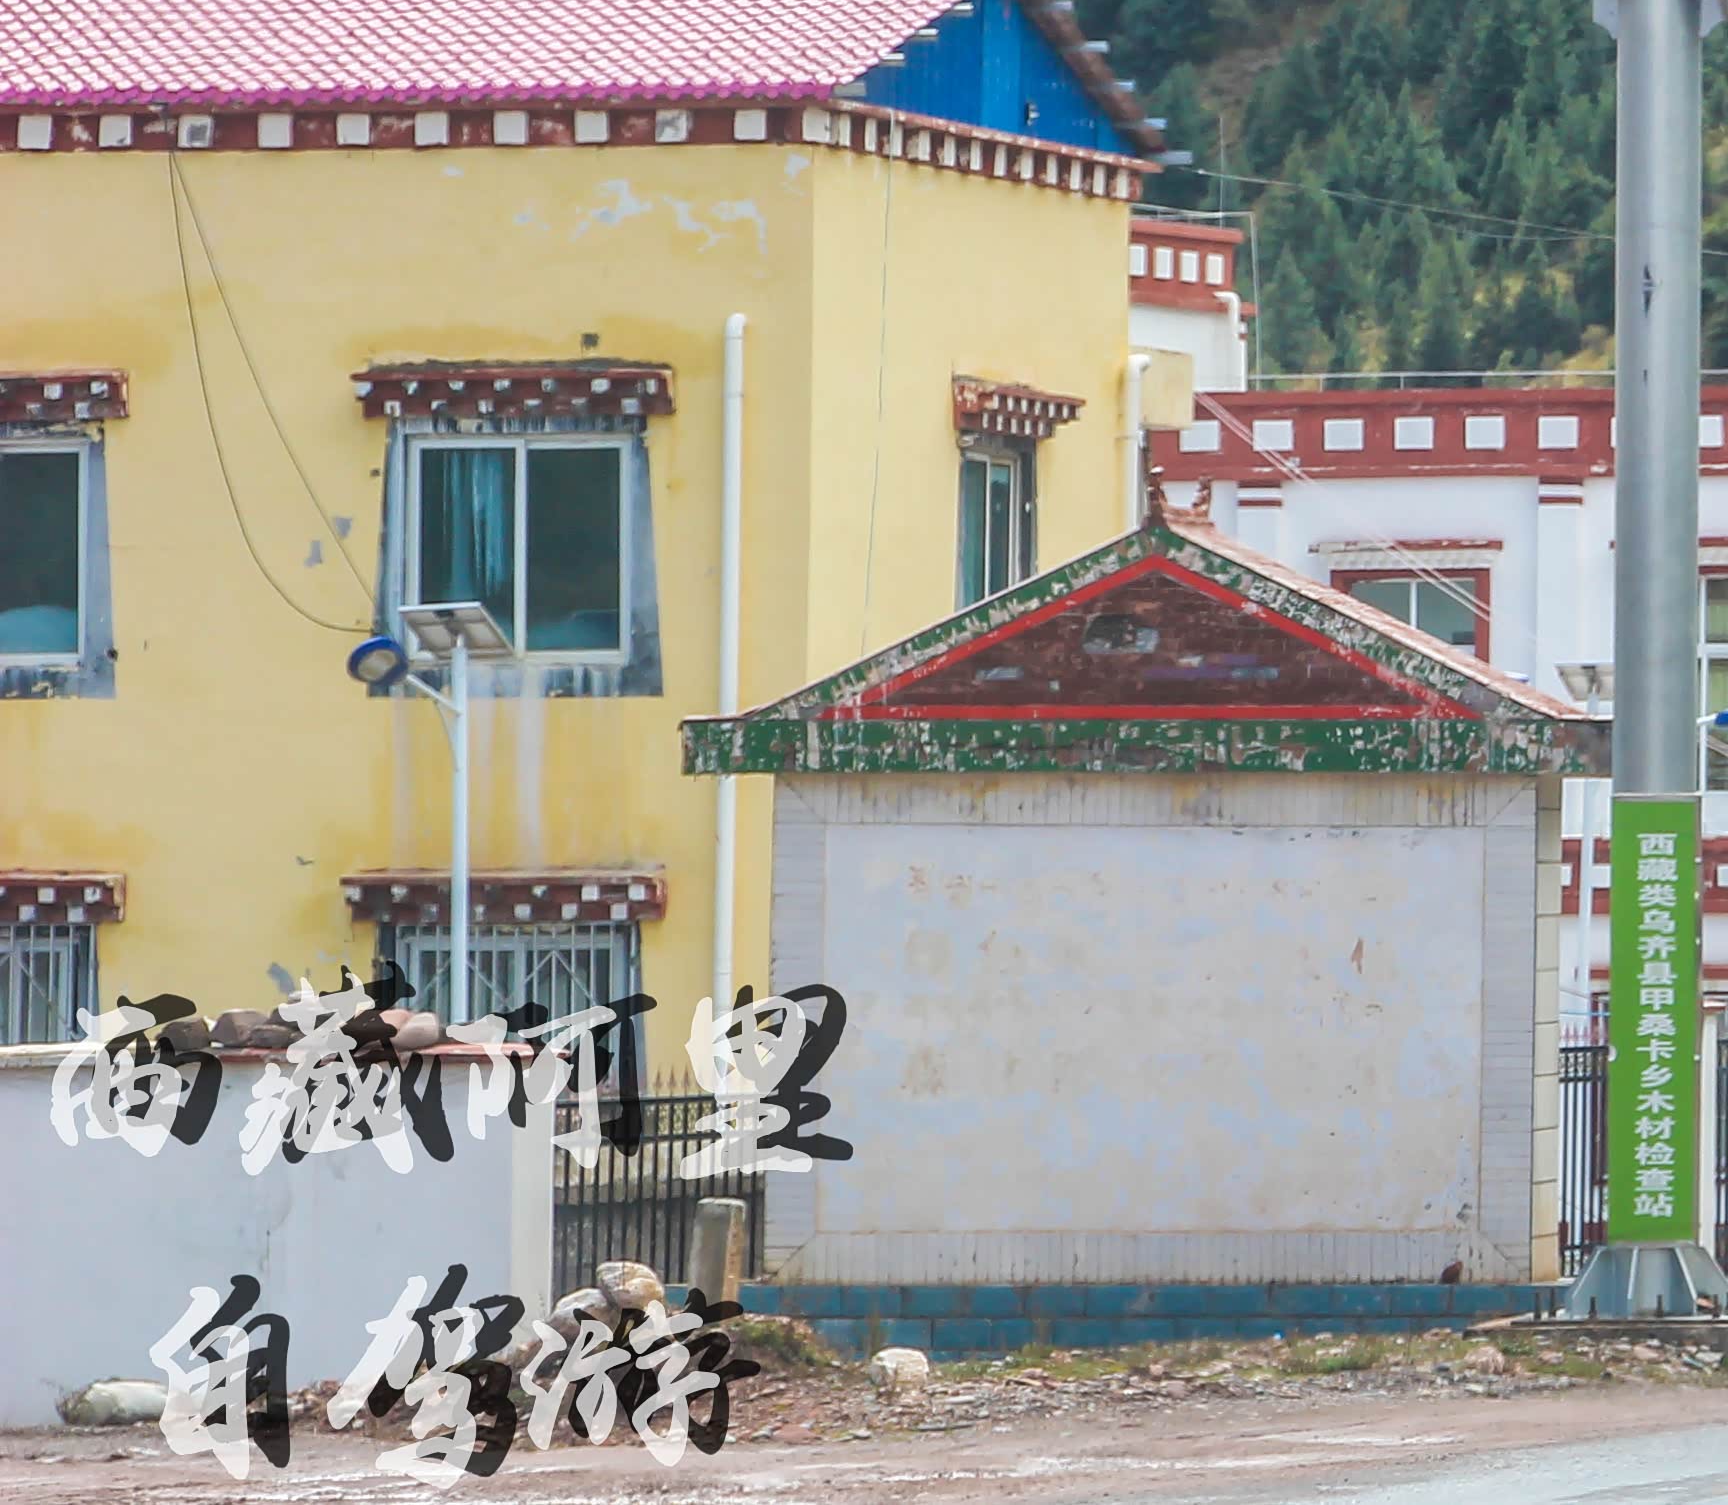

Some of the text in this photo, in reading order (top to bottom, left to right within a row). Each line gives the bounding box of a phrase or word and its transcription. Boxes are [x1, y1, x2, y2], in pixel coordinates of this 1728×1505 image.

[1633, 832, 1679, 1219] 西藏类乌齐县甲桑卡乡木材检查站
